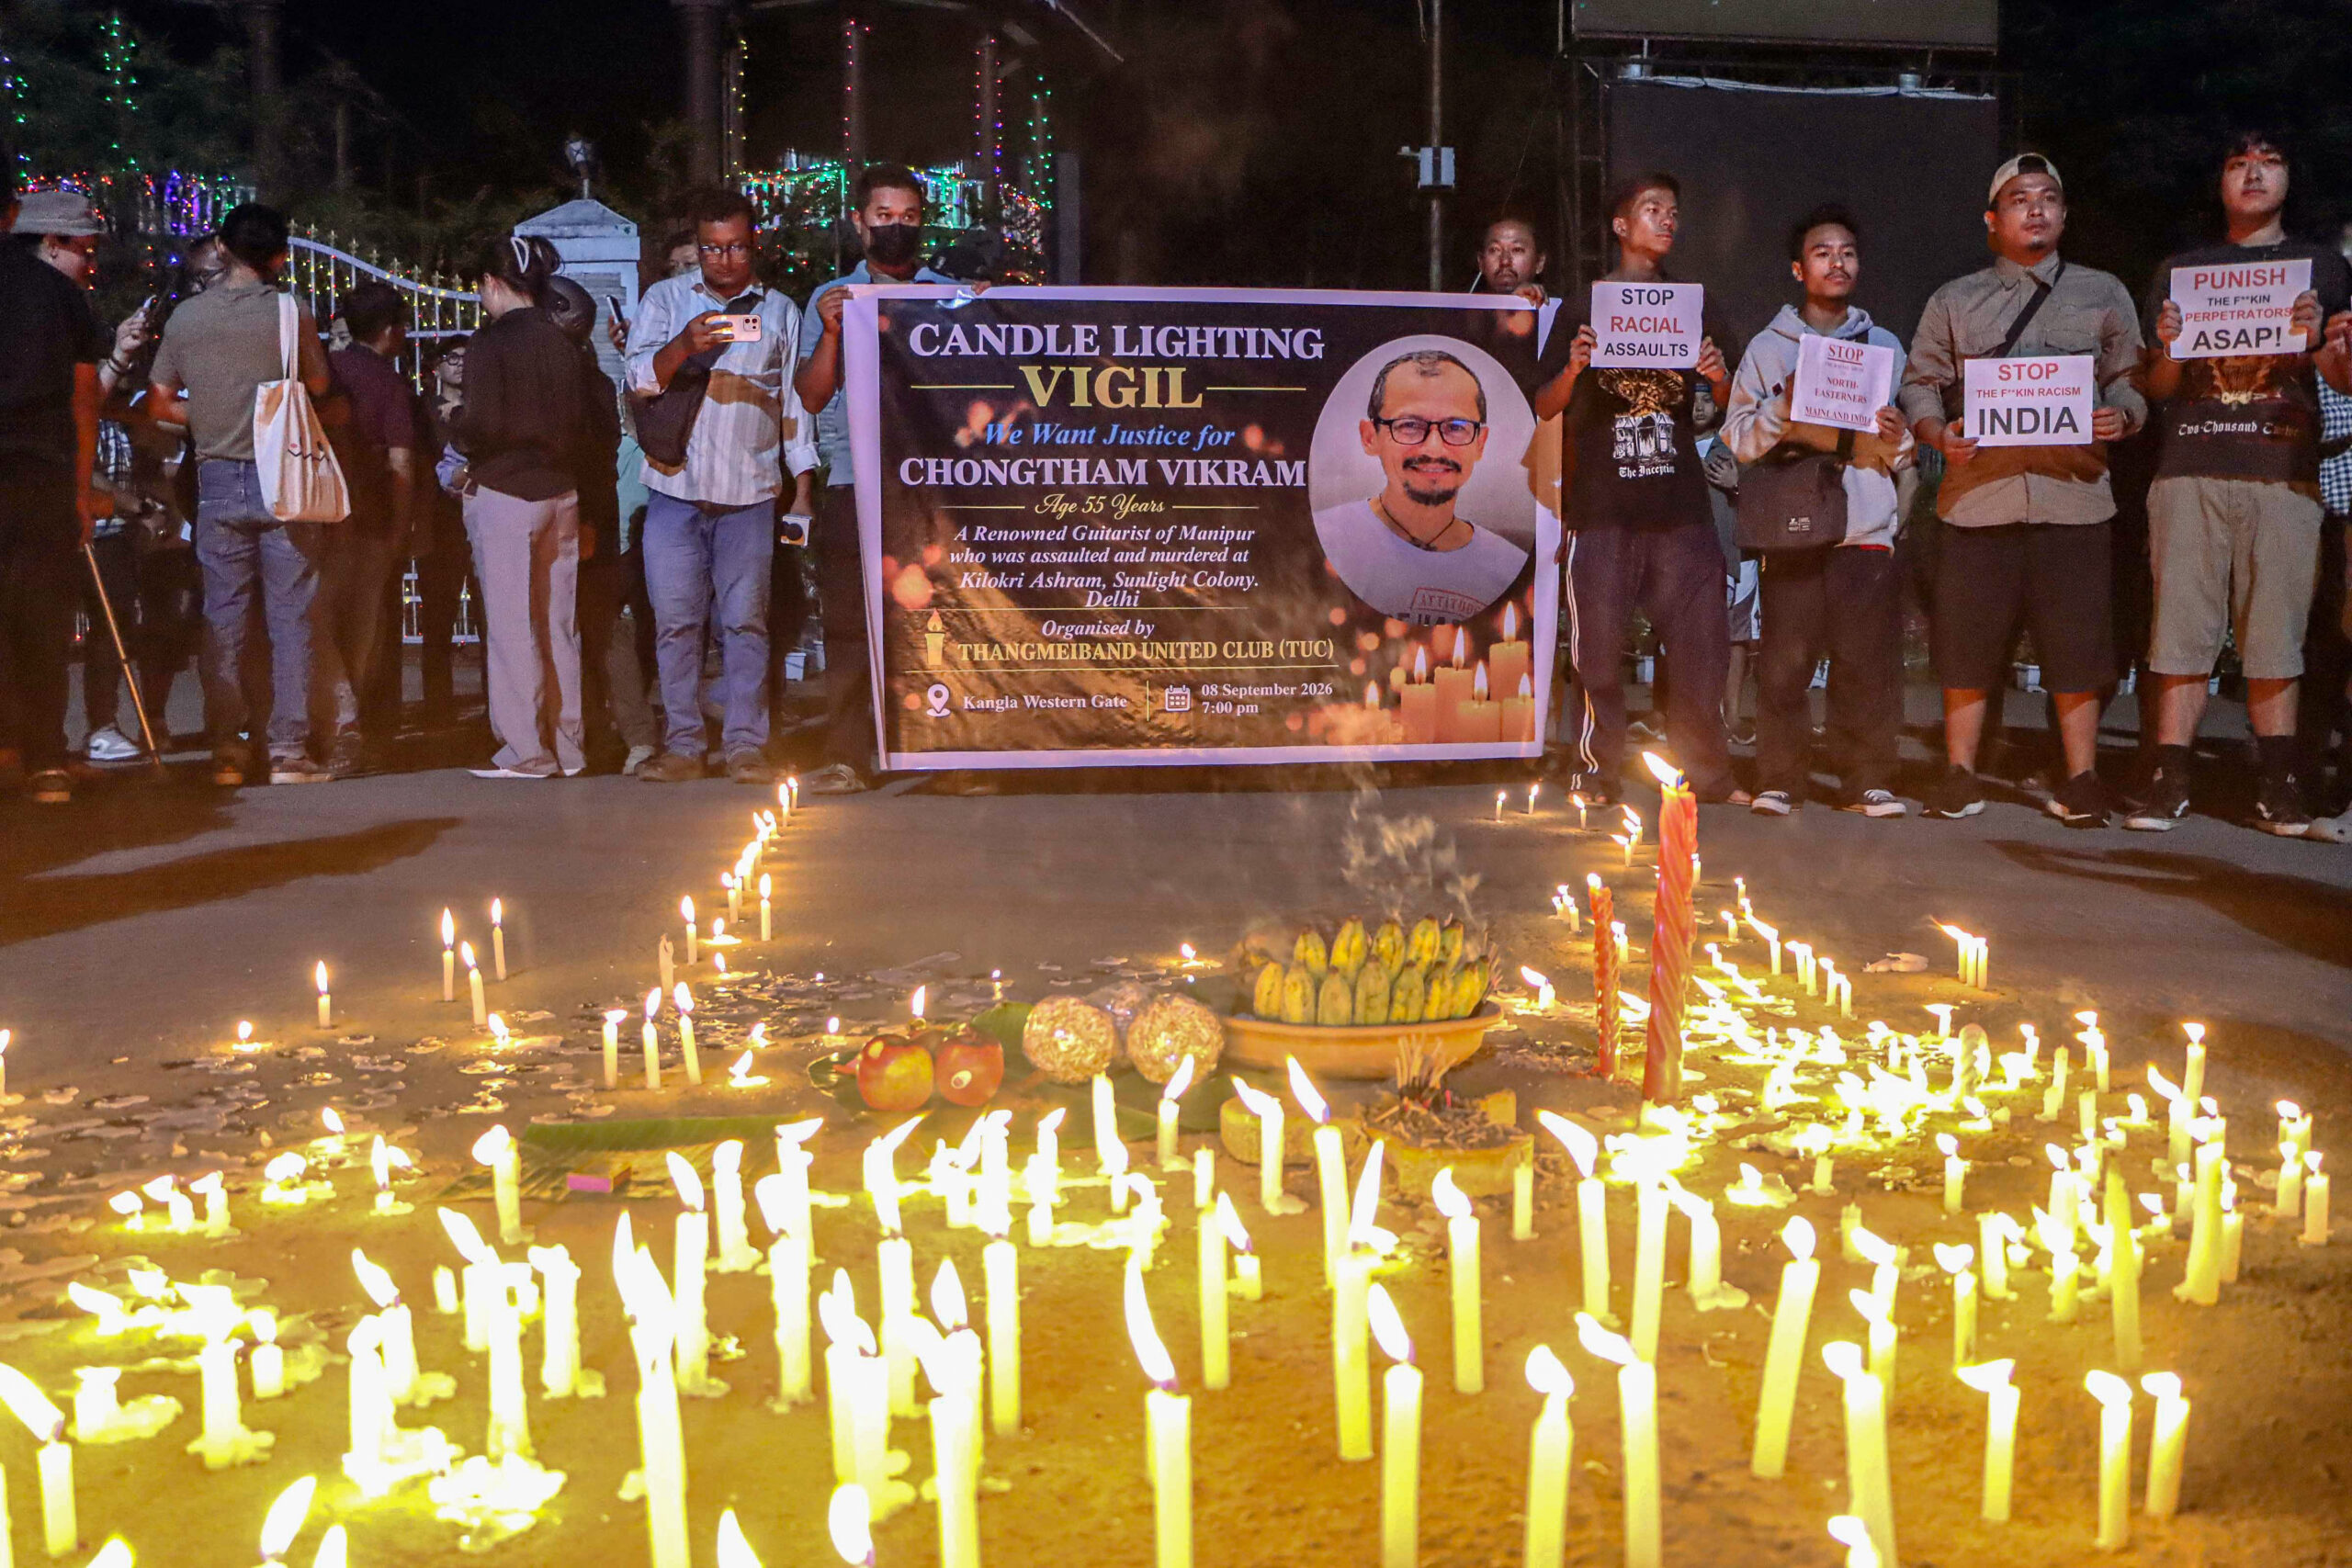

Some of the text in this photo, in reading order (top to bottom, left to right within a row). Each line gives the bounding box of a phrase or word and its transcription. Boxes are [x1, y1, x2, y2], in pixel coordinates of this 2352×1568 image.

[2194, 266, 2286, 289] PUNISH
[1621, 288, 1674, 305] STOP
[2207, 297, 2230, 307] THE
[2185, 307, 2292, 322] PERPETRATORS
[1611, 316, 1684, 333] RACIAL
[910, 322, 1325, 360] CANDLE LIGHTING
[2192, 327, 2282, 351] ASAP!
[1603, 343, 1689, 357] ASSAULTS
[1827, 344, 1864, 362] STOP
[1997, 363, 2059, 381] STOP
[1019, 365, 1203, 409] VIGIL
[1815, 388, 1868, 404] EASTERNERS
[1976, 389, 1999, 399] THE
[2038, 386, 2081, 397] RACISM
[1978, 406, 2079, 436] INDIA
[985, 423, 1236, 451] We Want Justice for
[899, 457, 1306, 487] CHONGTHAM VIKRAM
[1619, 466, 1636, 479] The
[1035, 493, 1165, 520] Age 55 Years
[954, 525, 1255, 545] A Renowned Guitarist of Manipur
[950, 547, 1250, 563] who was assaulted and murdered at
[959, 570, 1259, 592] Kilokri Ashram, Sunlight Colony.
[1085, 591, 1140, 607] Delhi
[1042, 619, 1155, 639] Organised by
[958, 638, 1334, 660] THANGMEIBAND UNITED CLUB (TUC)
[1202, 682, 1333, 699] 08 September 2026
[965, 694, 1127, 712] Kangla Western Gate
[1202, 701, 1259, 716] 7:00 pm
